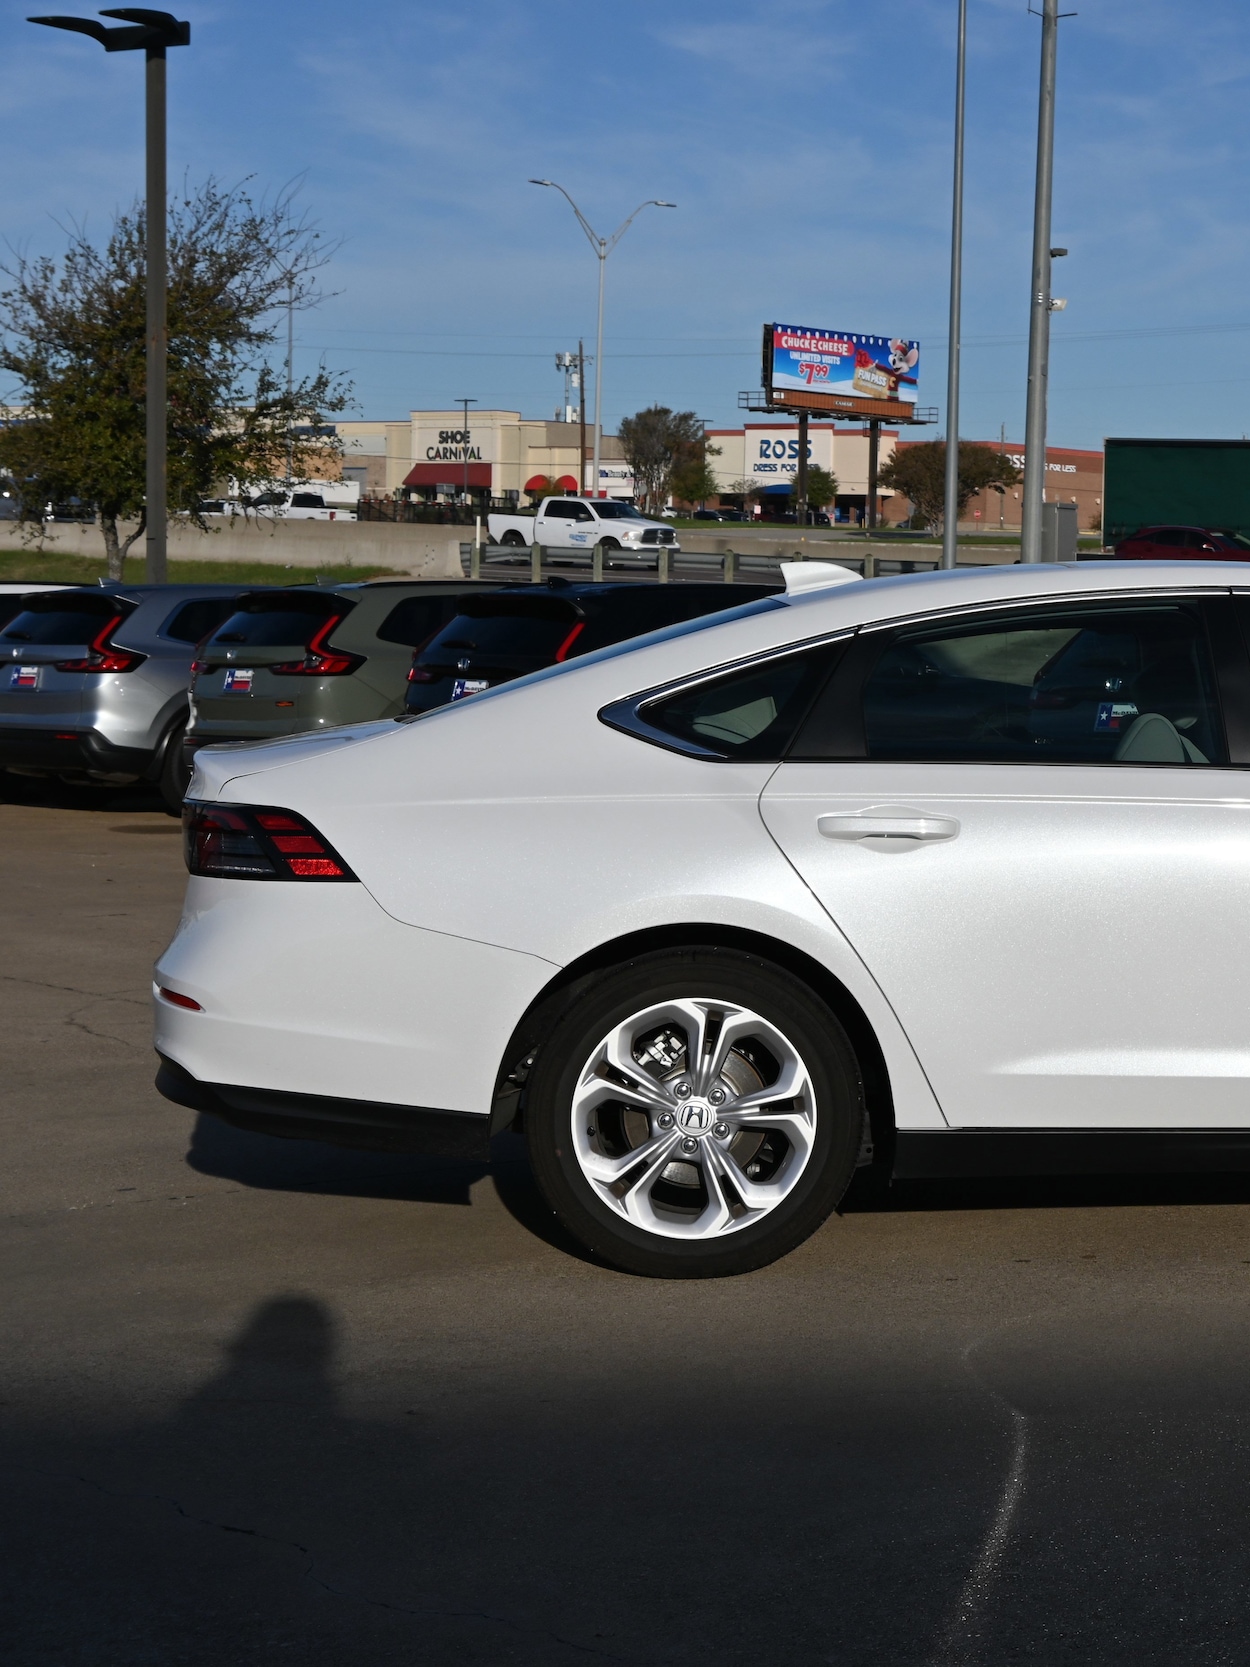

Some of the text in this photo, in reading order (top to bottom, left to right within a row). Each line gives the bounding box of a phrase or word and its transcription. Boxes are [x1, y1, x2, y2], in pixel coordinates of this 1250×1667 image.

[781, 335, 810, 349] CHUCK
[818, 340, 849, 356] CHEESE
[789, 350, 841, 365] UNLIMITED VISITS
[858, 369, 871, 382] FUN
[870, 373, 888, 388] PASS
[438, 430, 470, 444] SHOE
[753, 463, 778, 472] DRESS
[781, 463, 797, 472] FOR
[1049, 463, 1061, 472] FOR
[1062, 464, 1077, 473] LESS
